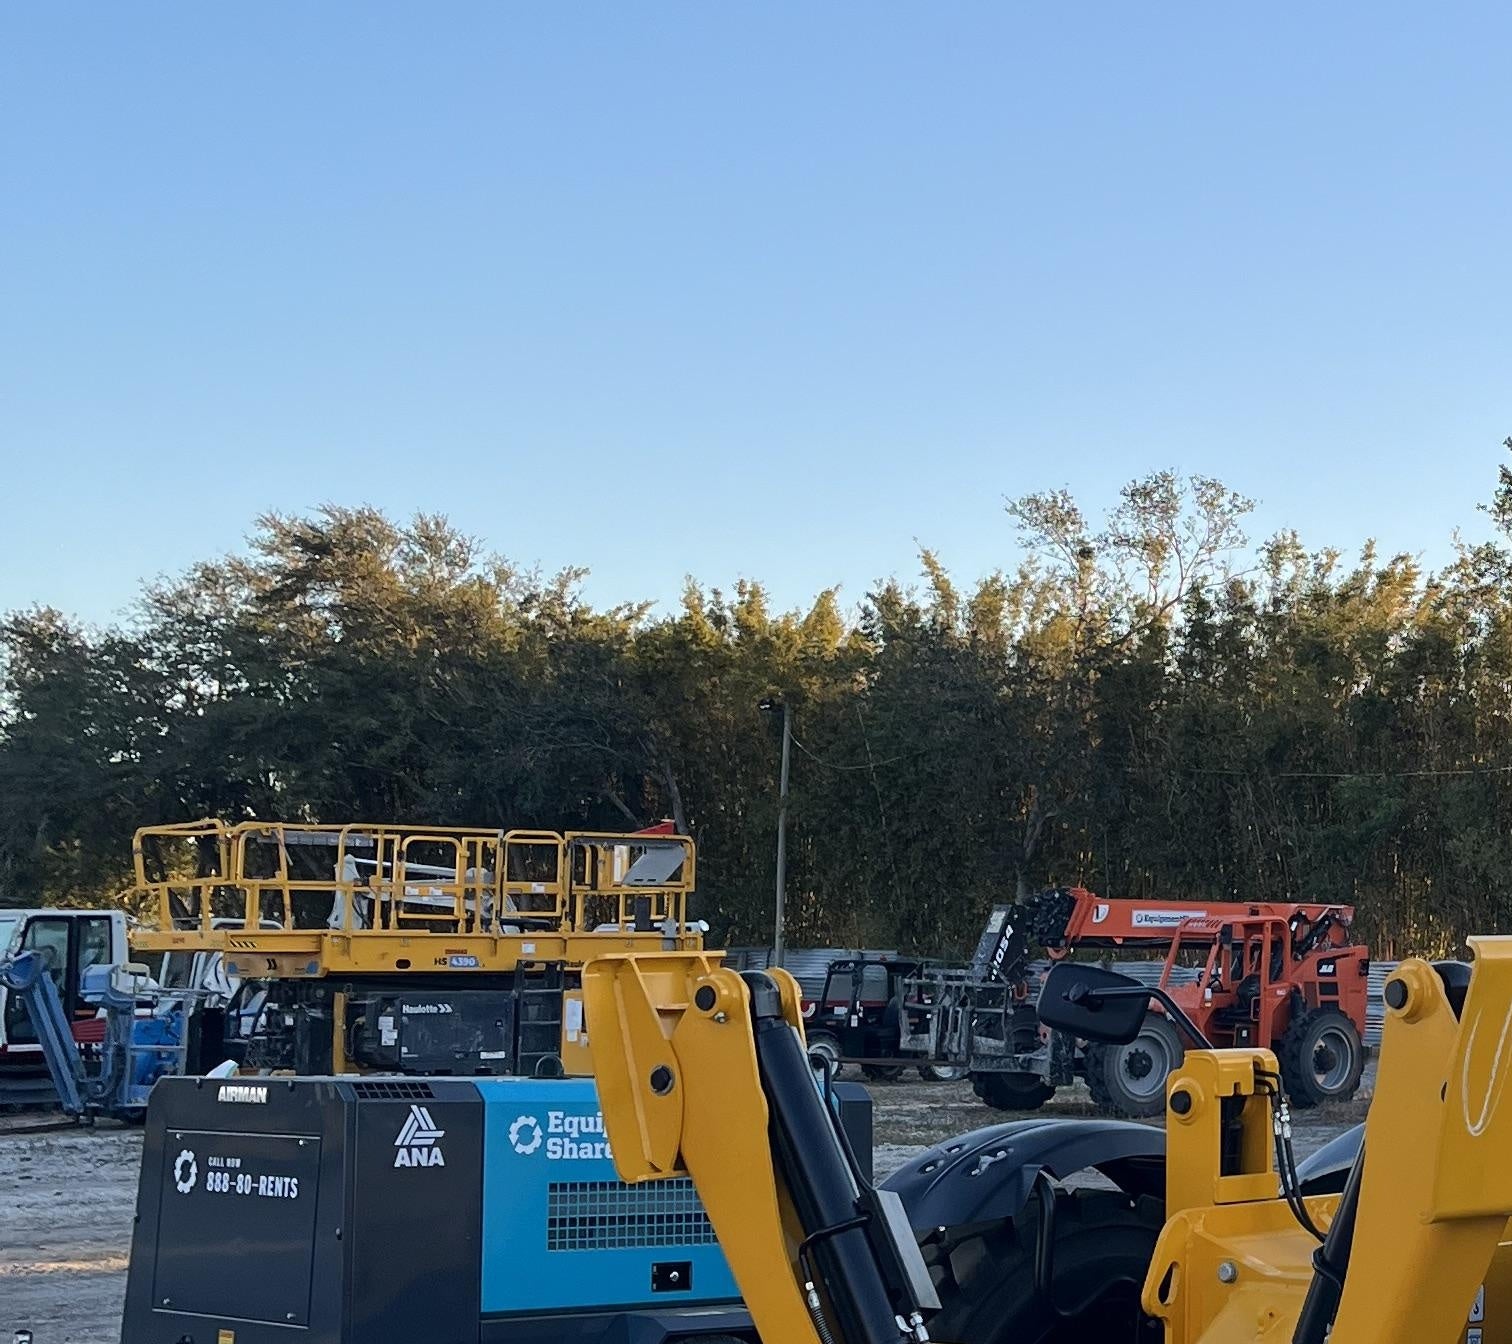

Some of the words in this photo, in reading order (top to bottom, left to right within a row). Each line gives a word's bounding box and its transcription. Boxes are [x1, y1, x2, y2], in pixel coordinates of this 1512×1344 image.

[433, 957, 448, 966] HS
[451, 956, 476, 967] 4390
[217, 1085, 268, 1104] AIRMAN
[547, 1111, 608, 1138] Equi
[208, 1156, 224, 1167] CALL
[226, 1158, 241, 1168] NOW
[394, 1147, 445, 1167] ANA
[206, 1171, 298, 1199] 888-80-RENTS
